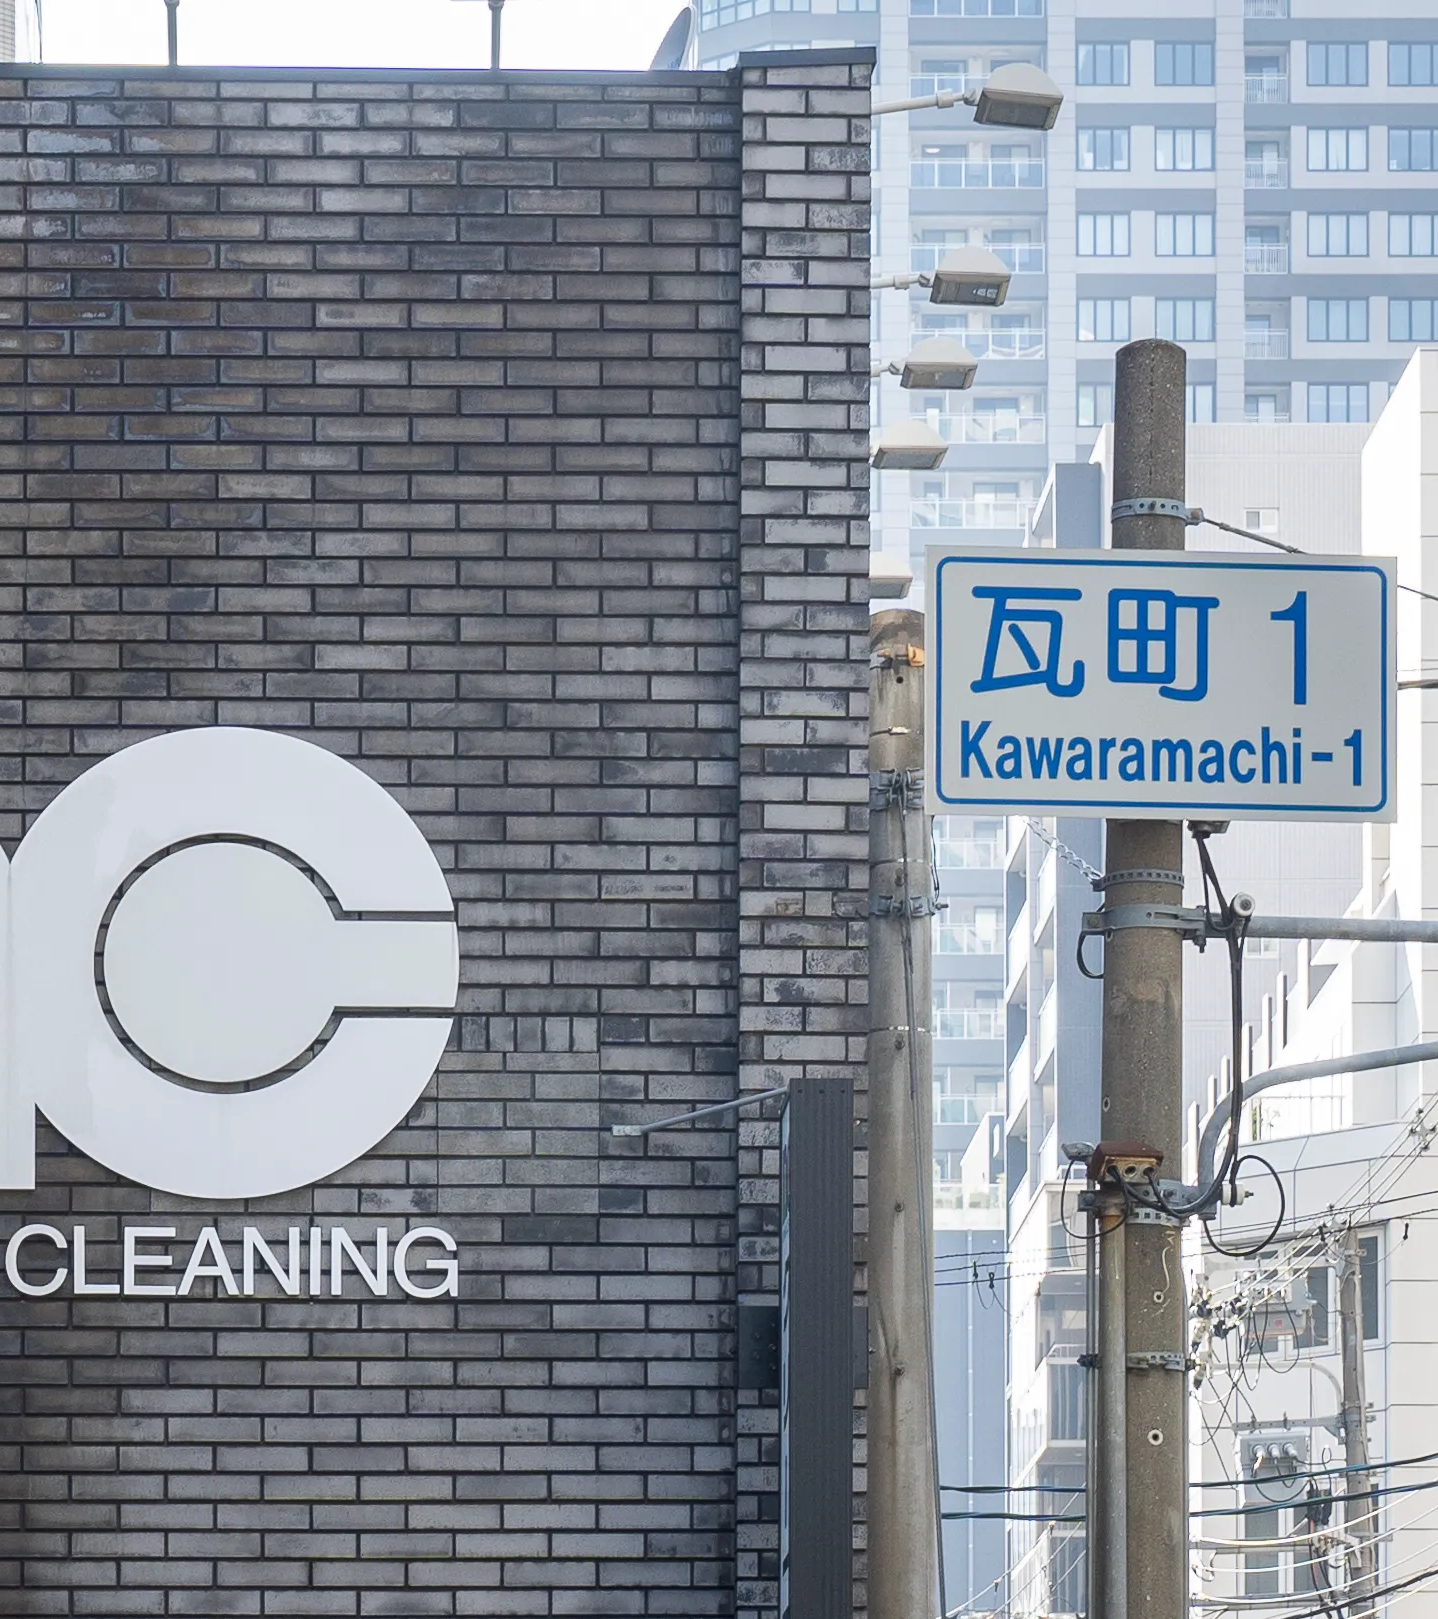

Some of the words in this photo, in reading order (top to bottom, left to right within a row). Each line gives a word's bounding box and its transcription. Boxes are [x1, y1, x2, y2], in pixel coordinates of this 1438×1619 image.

[970, 585, 1220, 702] 瓦町
[1270, 590, 1307, 705] 1
[960, 720, 1362, 787] Kawaramachi-1
[4, 1224, 459, 1300] CLEANING
